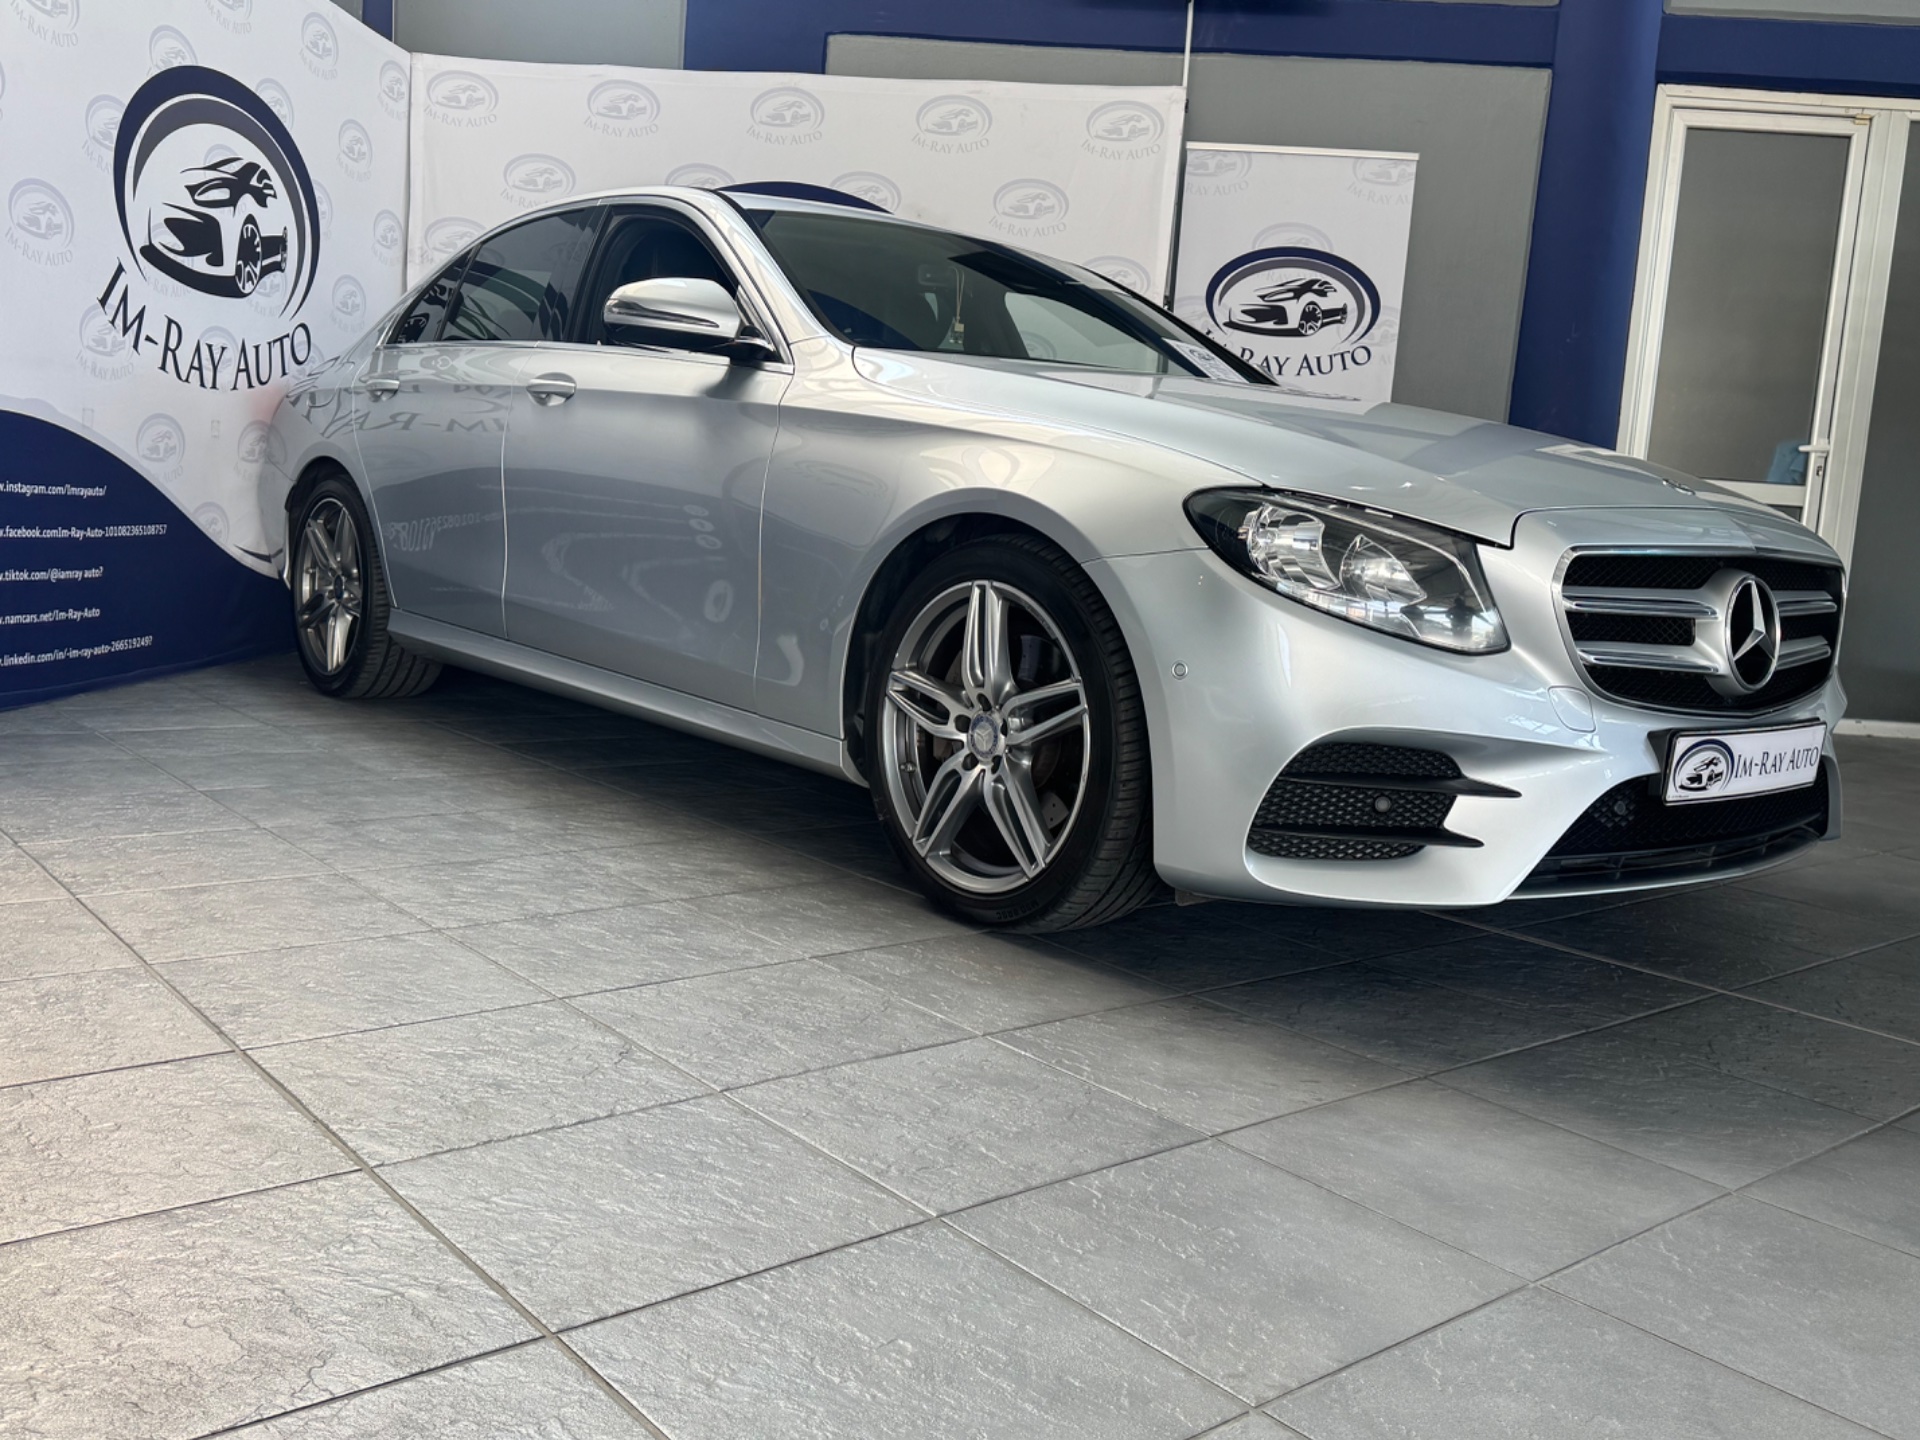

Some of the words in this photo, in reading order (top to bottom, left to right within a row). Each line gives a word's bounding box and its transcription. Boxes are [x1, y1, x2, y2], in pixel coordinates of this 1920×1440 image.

[50, 30, 79, 48] AUTO
[423, 104, 463, 128] IM-RAY
[465, 113, 498, 128] AUTO
[583, 116, 625, 138] IM-RAY
[626, 123, 659, 138] AUTO
[746, 125, 788, 146] IM-RAY
[789, 130, 822, 146] AUTO
[911, 132, 953, 154] IM-RAY
[955, 137, 990, 153] AUTO
[1081, 139, 1124, 161] IM-RAY
[1126, 143, 1161, 161] AUTO
[1213, 180, 1250, 196] AUTO
[988, 215, 1031, 237] IM-RAY
[1033, 221, 1068, 237] AUTO
[5, 226, 43, 265] IM-RAY
[45, 249, 73, 266] AUTO
[97, 256, 227, 391] IM-RAY
[230, 322, 312, 391] AUTO
[1296, 345, 1372, 377] AUTO
[1734, 750, 1787, 779] IM-RAY
[1785, 746, 1819, 772] AUTO
